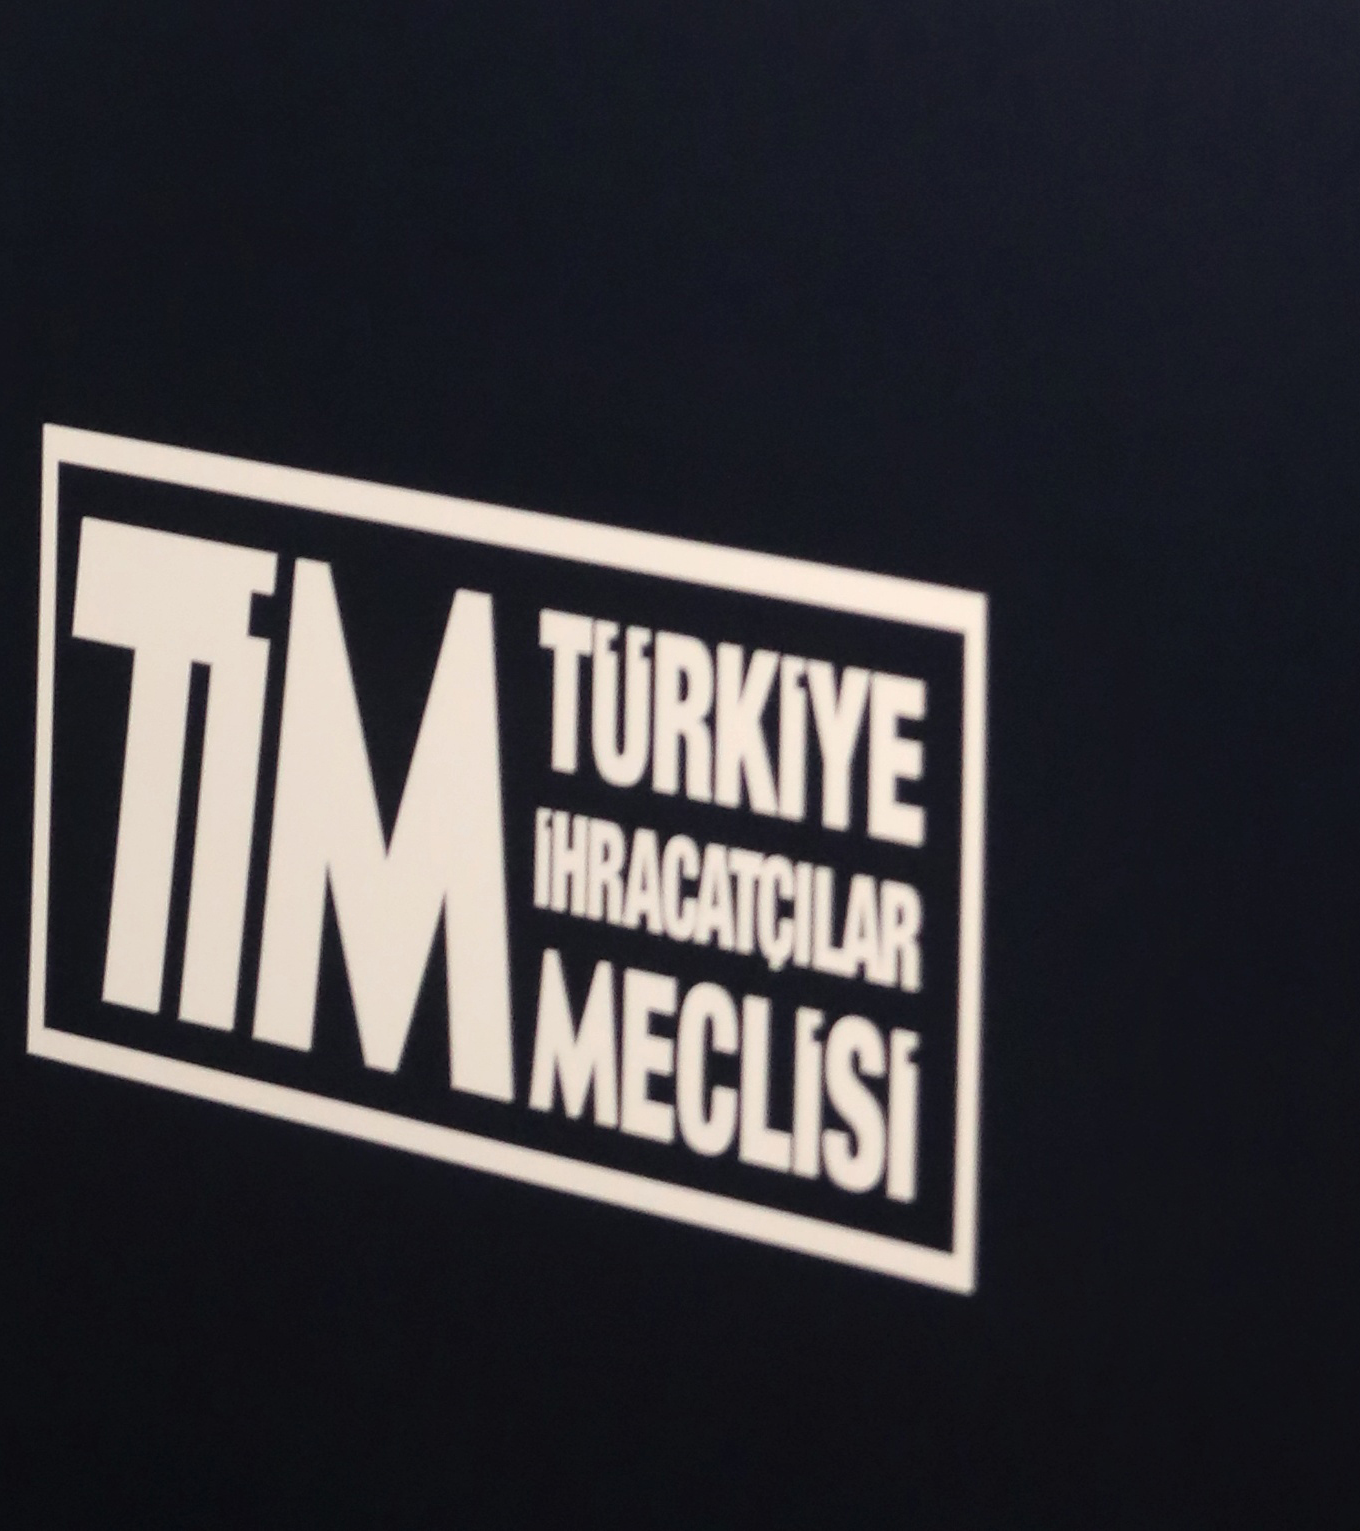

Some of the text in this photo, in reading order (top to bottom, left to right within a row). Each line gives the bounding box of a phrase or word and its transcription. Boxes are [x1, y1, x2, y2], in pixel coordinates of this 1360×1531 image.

[72, 516, 514, 1104] TİM
[539, 607, 927, 849] TÜRKİYE
[534, 806, 922, 994] İHRACATÇILAR
[528, 946, 919, 1204] MECLİSİ
